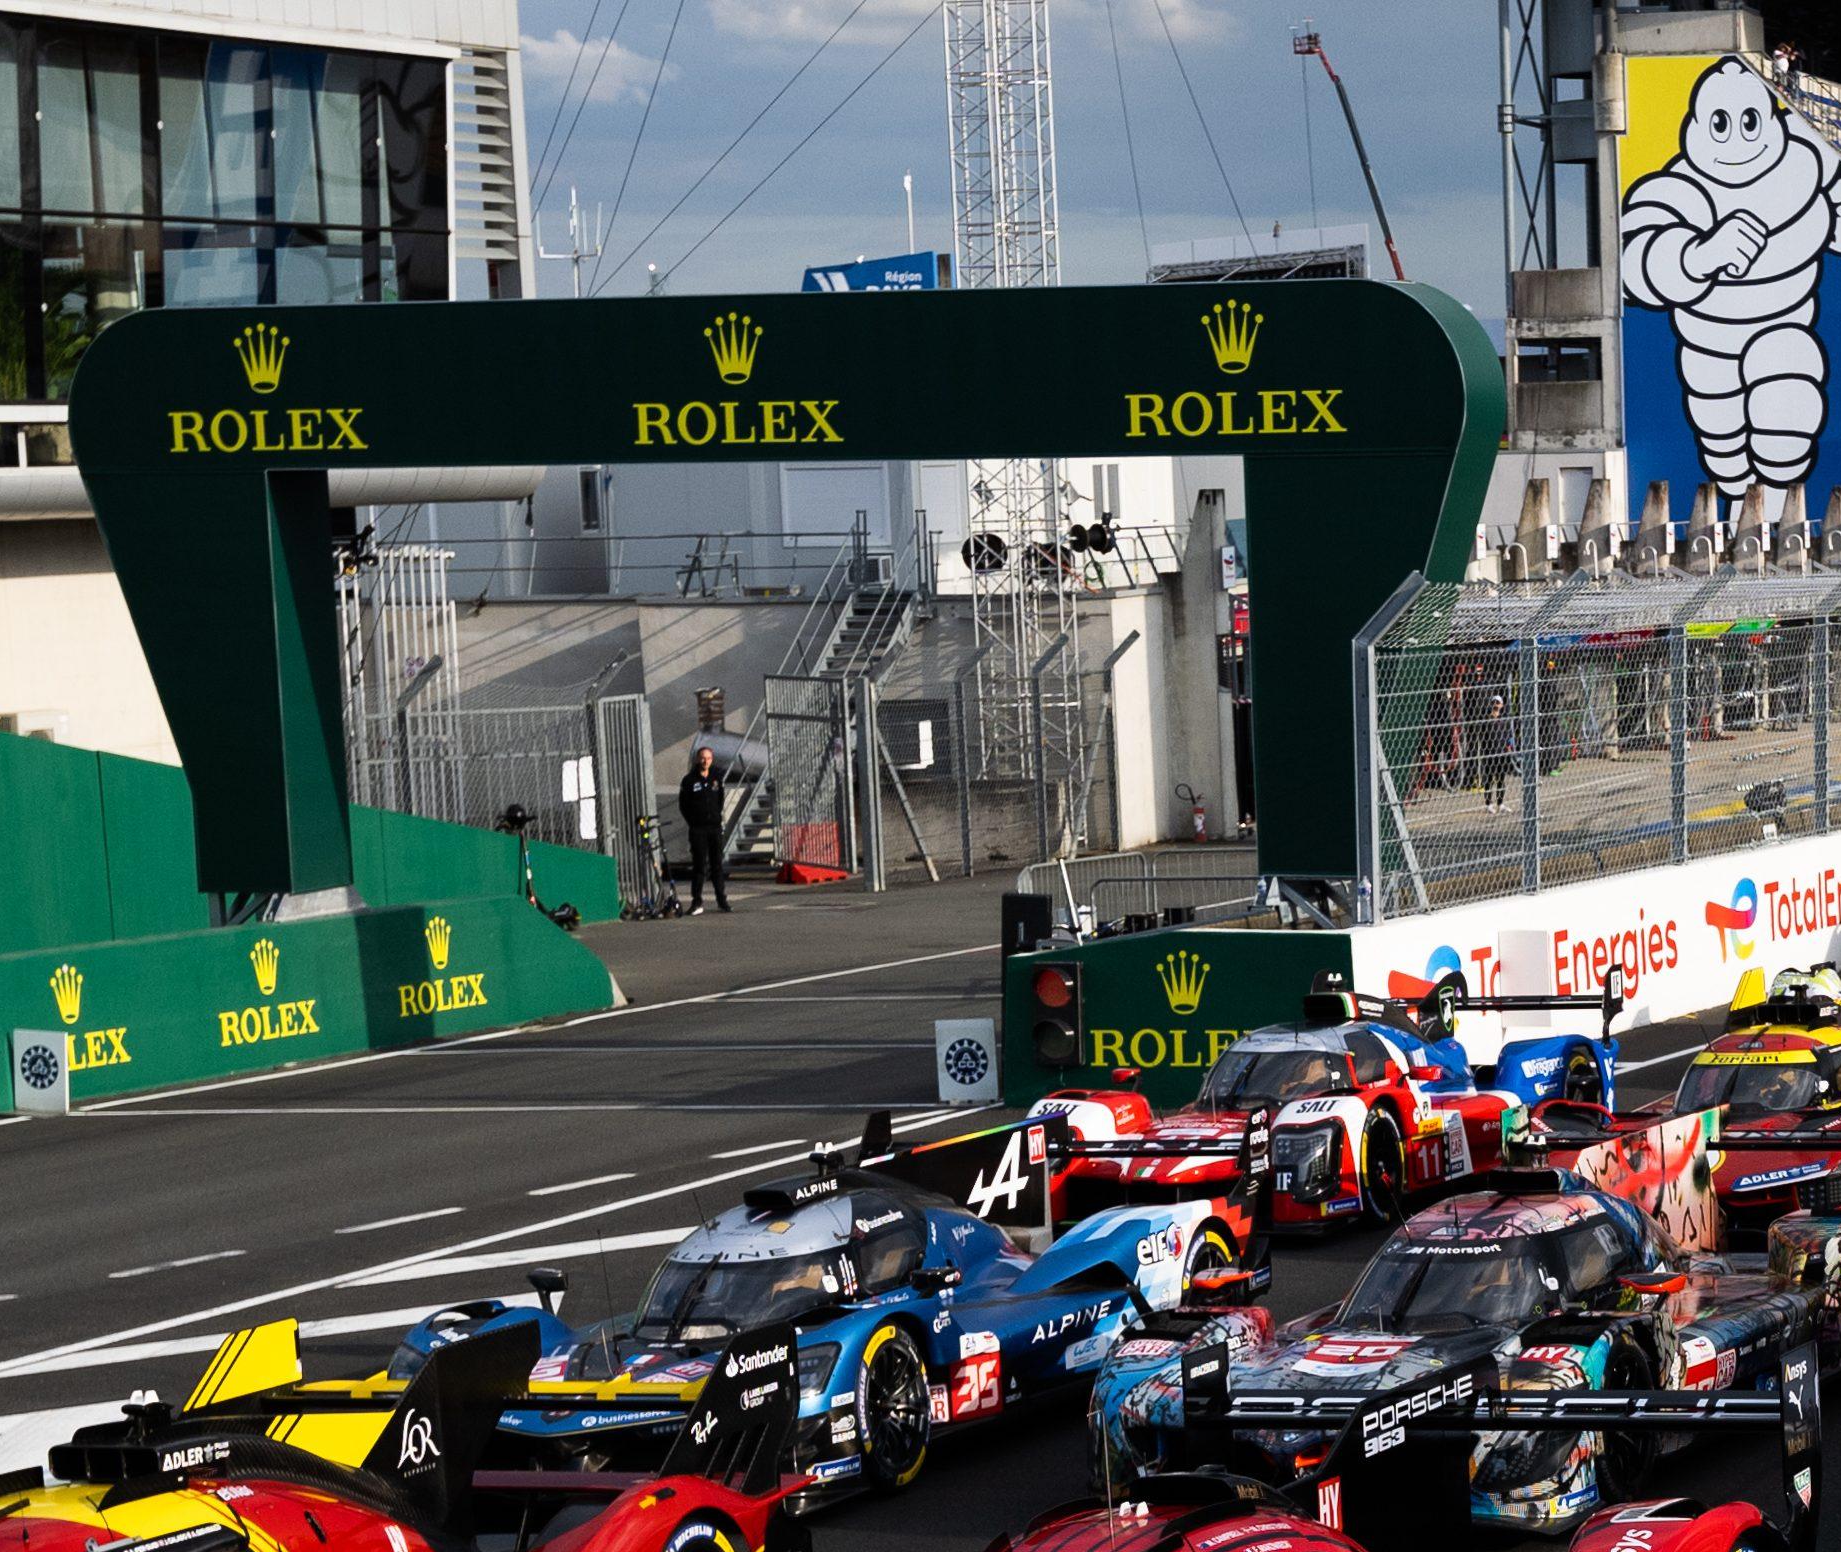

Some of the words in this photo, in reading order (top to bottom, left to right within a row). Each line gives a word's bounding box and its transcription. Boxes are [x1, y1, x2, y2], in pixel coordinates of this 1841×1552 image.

[885, 270, 922, 283] Région
[632, 399, 841, 446] ROLEX
[1124, 389, 1348, 438] ROLEX
[167, 407, 368, 455] ROLEX
[397, 972, 489, 1018] ROLEX
[217, 999, 321, 1049] ROLEX
[66, 1026, 133, 1073] LEX
[1090, 1028, 1253, 1068] ROLE
[1708, 1053, 1781, 1065] Ferrari
[1296, 1099, 1339, 1114] SALT
[1030, 1129, 1046, 1162] HY
[1417, 1141, 1441, 1180] 11
[795, 1177, 839, 1201] ALPINE
[1739, 1169, 1790, 1188] ADLER
[1136, 1232, 1169, 1267] elf
[1426, 1243, 1502, 1256] Motorsport
[1031, 1300, 1112, 1345] ALPINE
[738, 1344, 789, 1374] Santander
[1521, 1346, 1568, 1360] HY
[955, 1358, 999, 1414] 35
[1784, 1359, 1808, 1384] Ansys
[1362, 1374, 1474, 1438] PORSCHE
[163, 1446, 205, 1472] ADLER
[1364, 1425, 1406, 1459] 963
[1319, 1481, 1341, 1529] HY
[671, 1522, 714, 1552] MICHELIN
